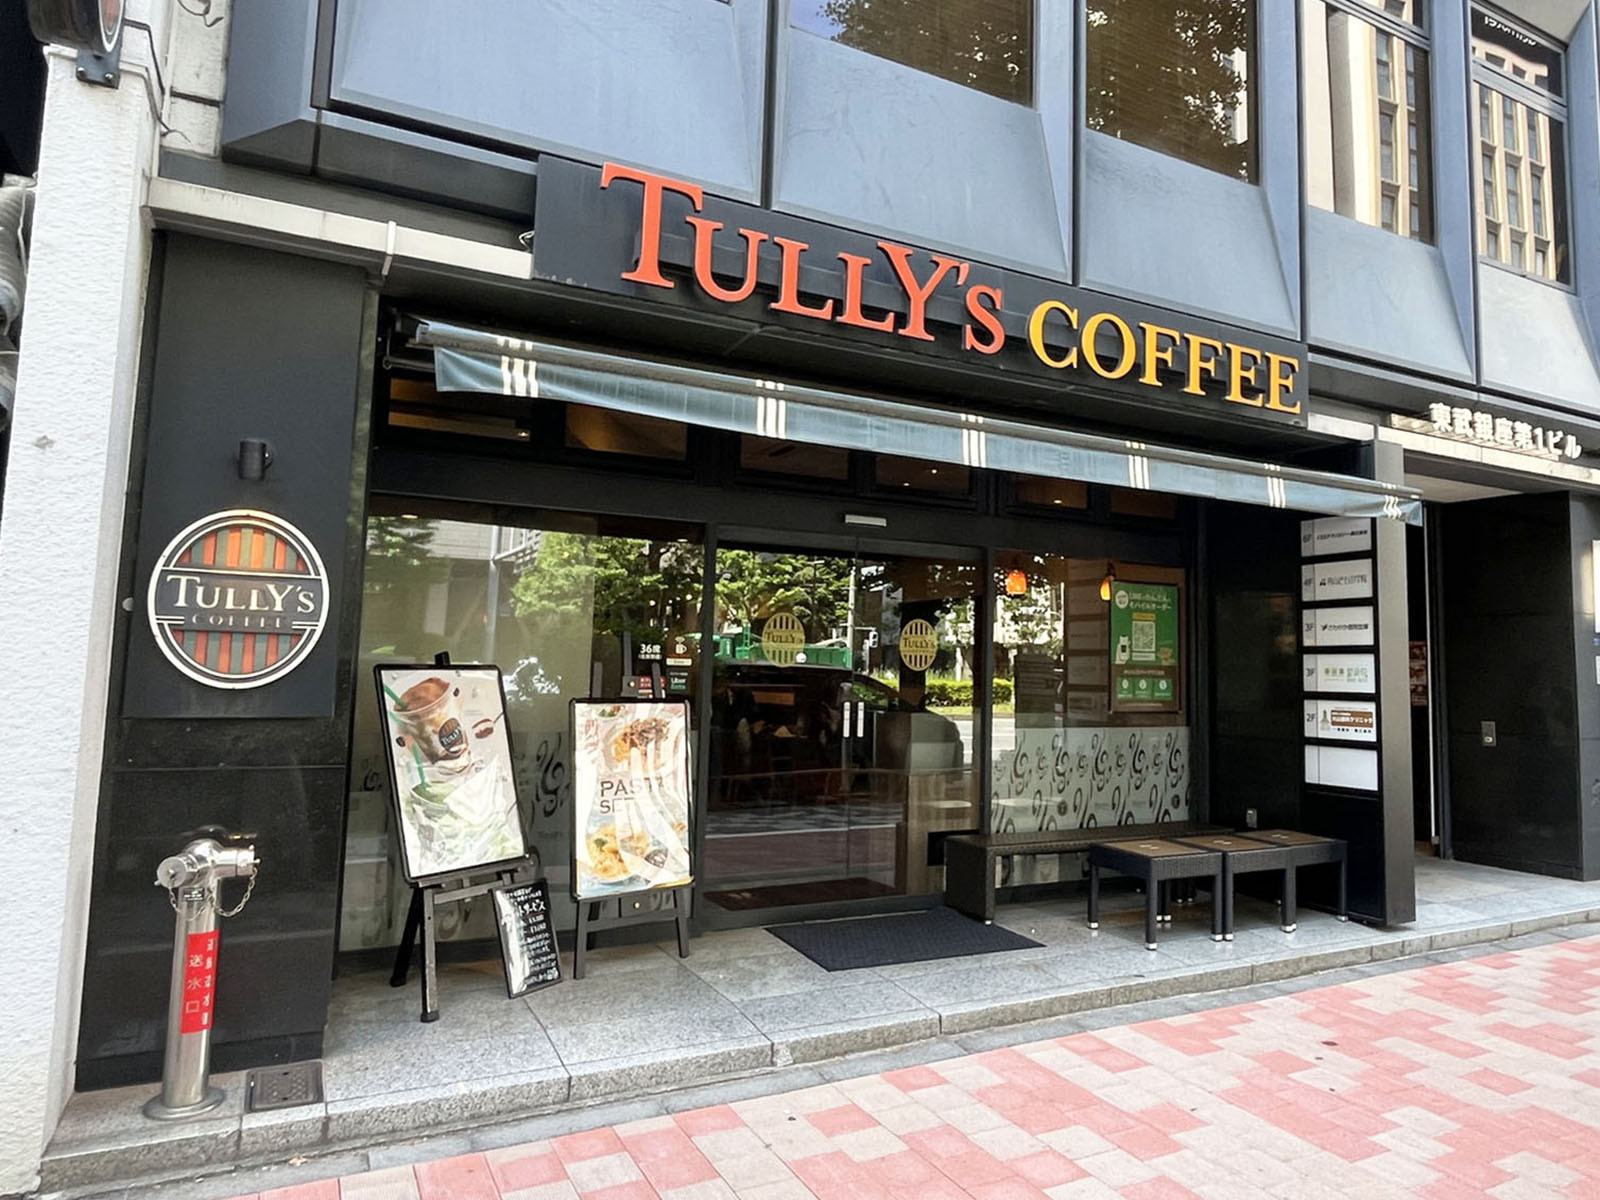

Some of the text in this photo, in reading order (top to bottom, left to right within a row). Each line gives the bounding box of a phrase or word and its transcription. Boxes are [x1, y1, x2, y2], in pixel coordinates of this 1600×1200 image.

[1028, 300, 1301, 414] COFFEE
[166, 574, 316, 613] TULLY'S
[185, 953, 203, 1014] 送水口
